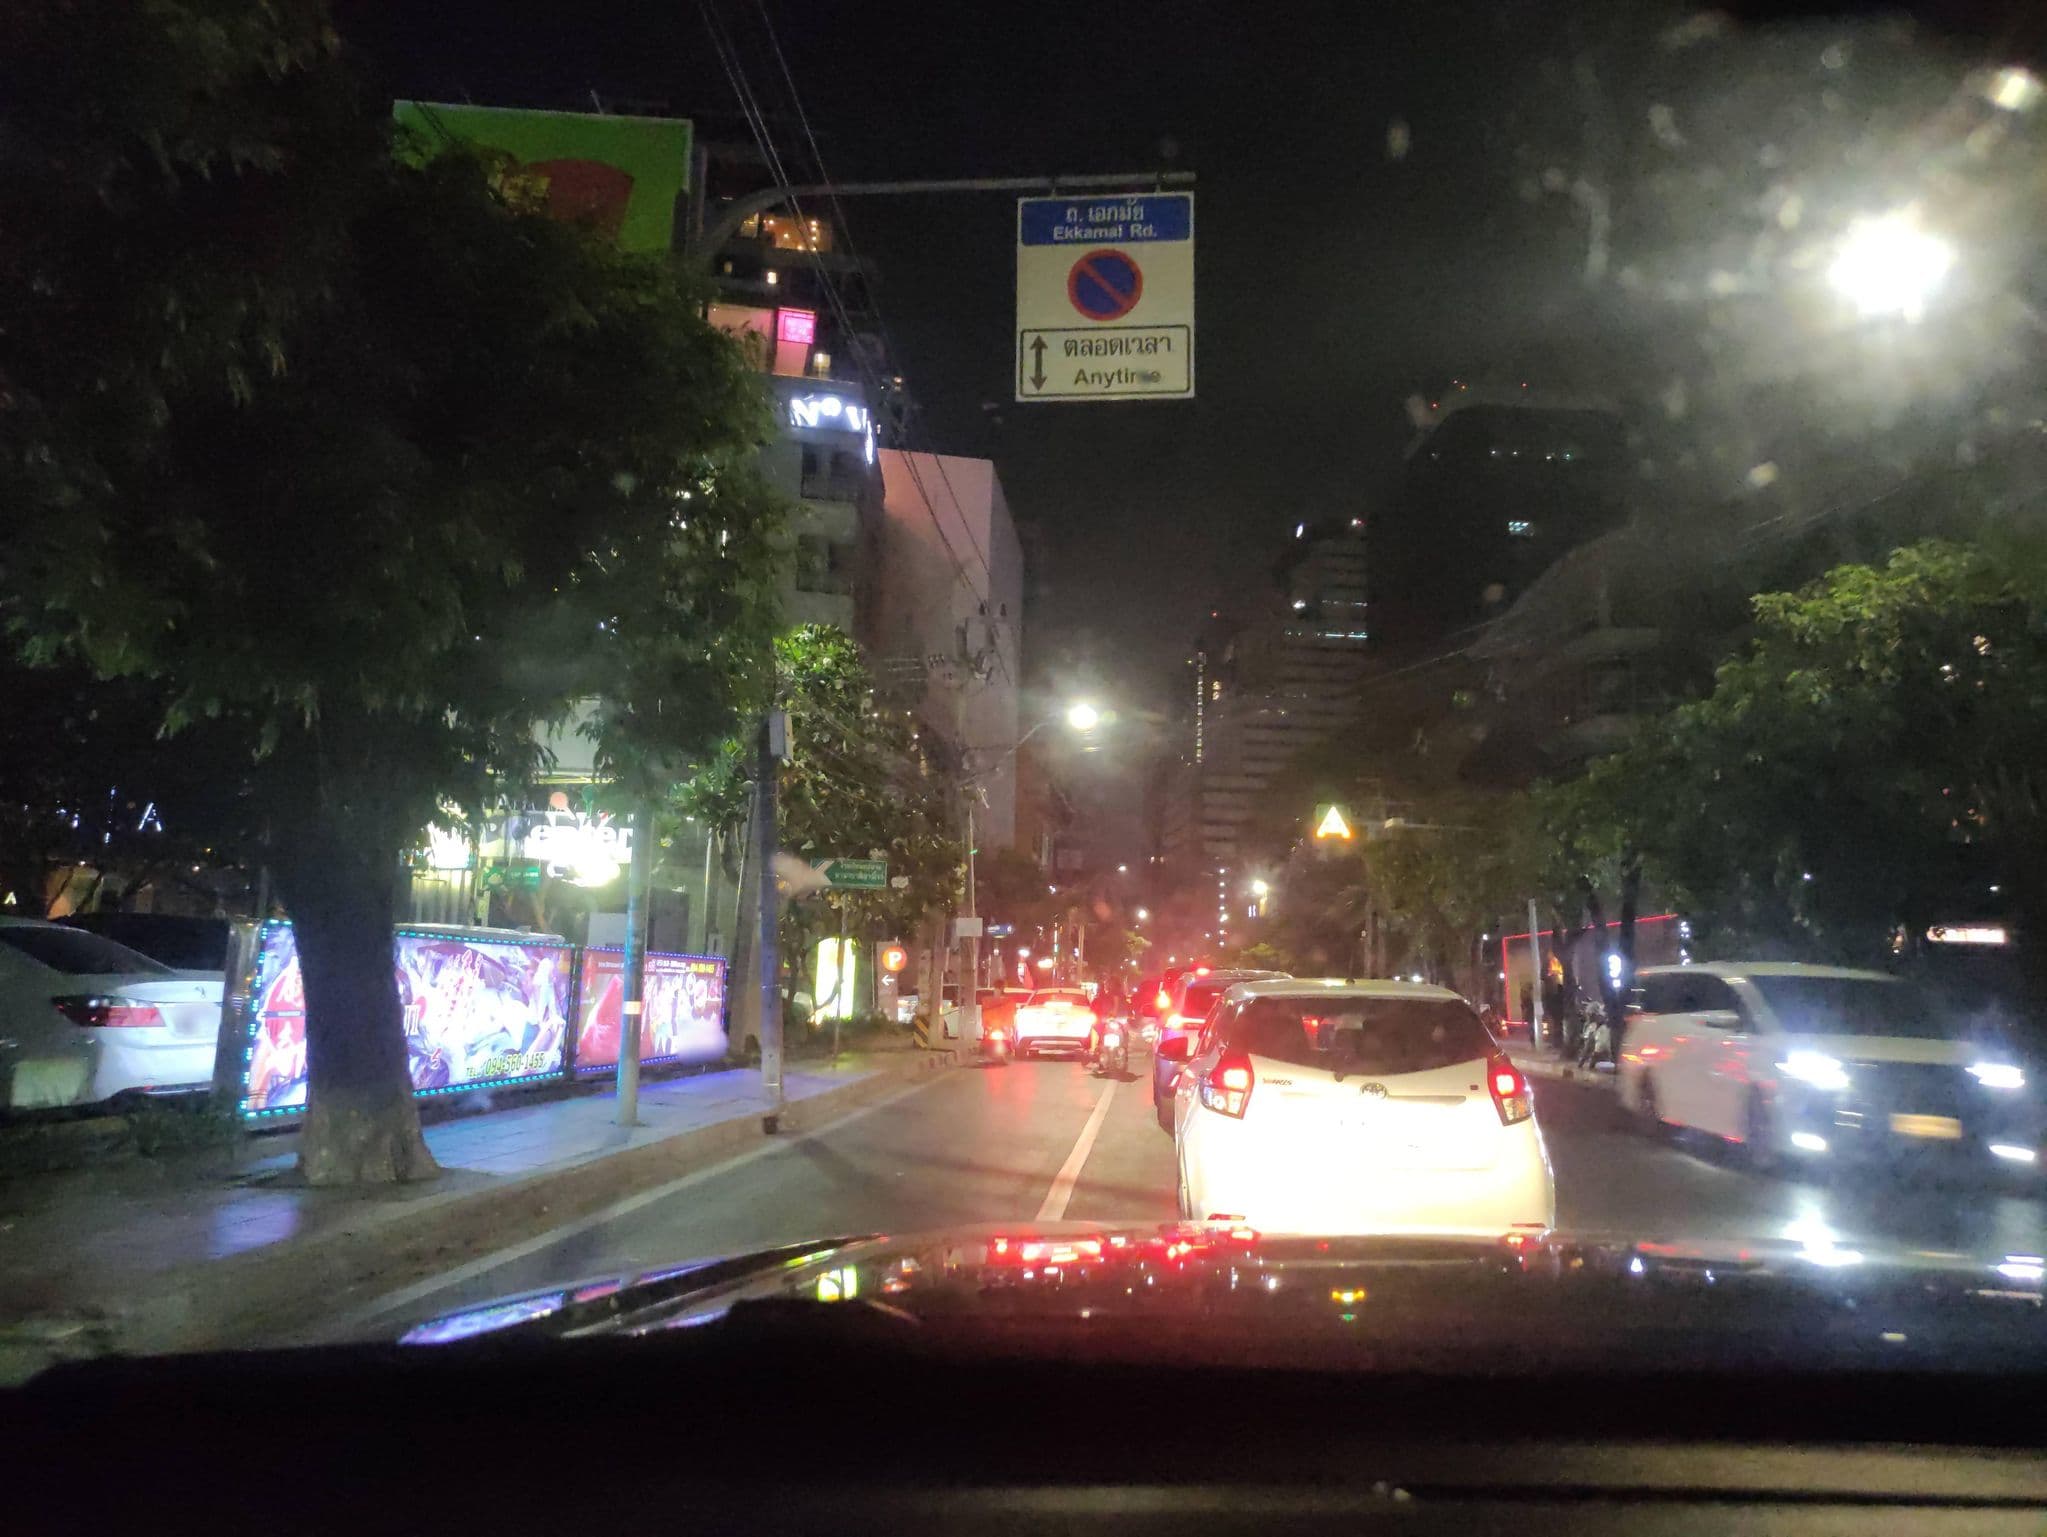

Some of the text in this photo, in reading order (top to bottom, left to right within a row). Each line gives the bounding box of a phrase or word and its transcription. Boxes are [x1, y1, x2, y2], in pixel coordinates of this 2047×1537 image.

[1053, 223, 1157, 241] Ekkamai Rd.
[1063, 336, 1172, 358] ตลอดเวลา
[888, 951, 902, 967] P
